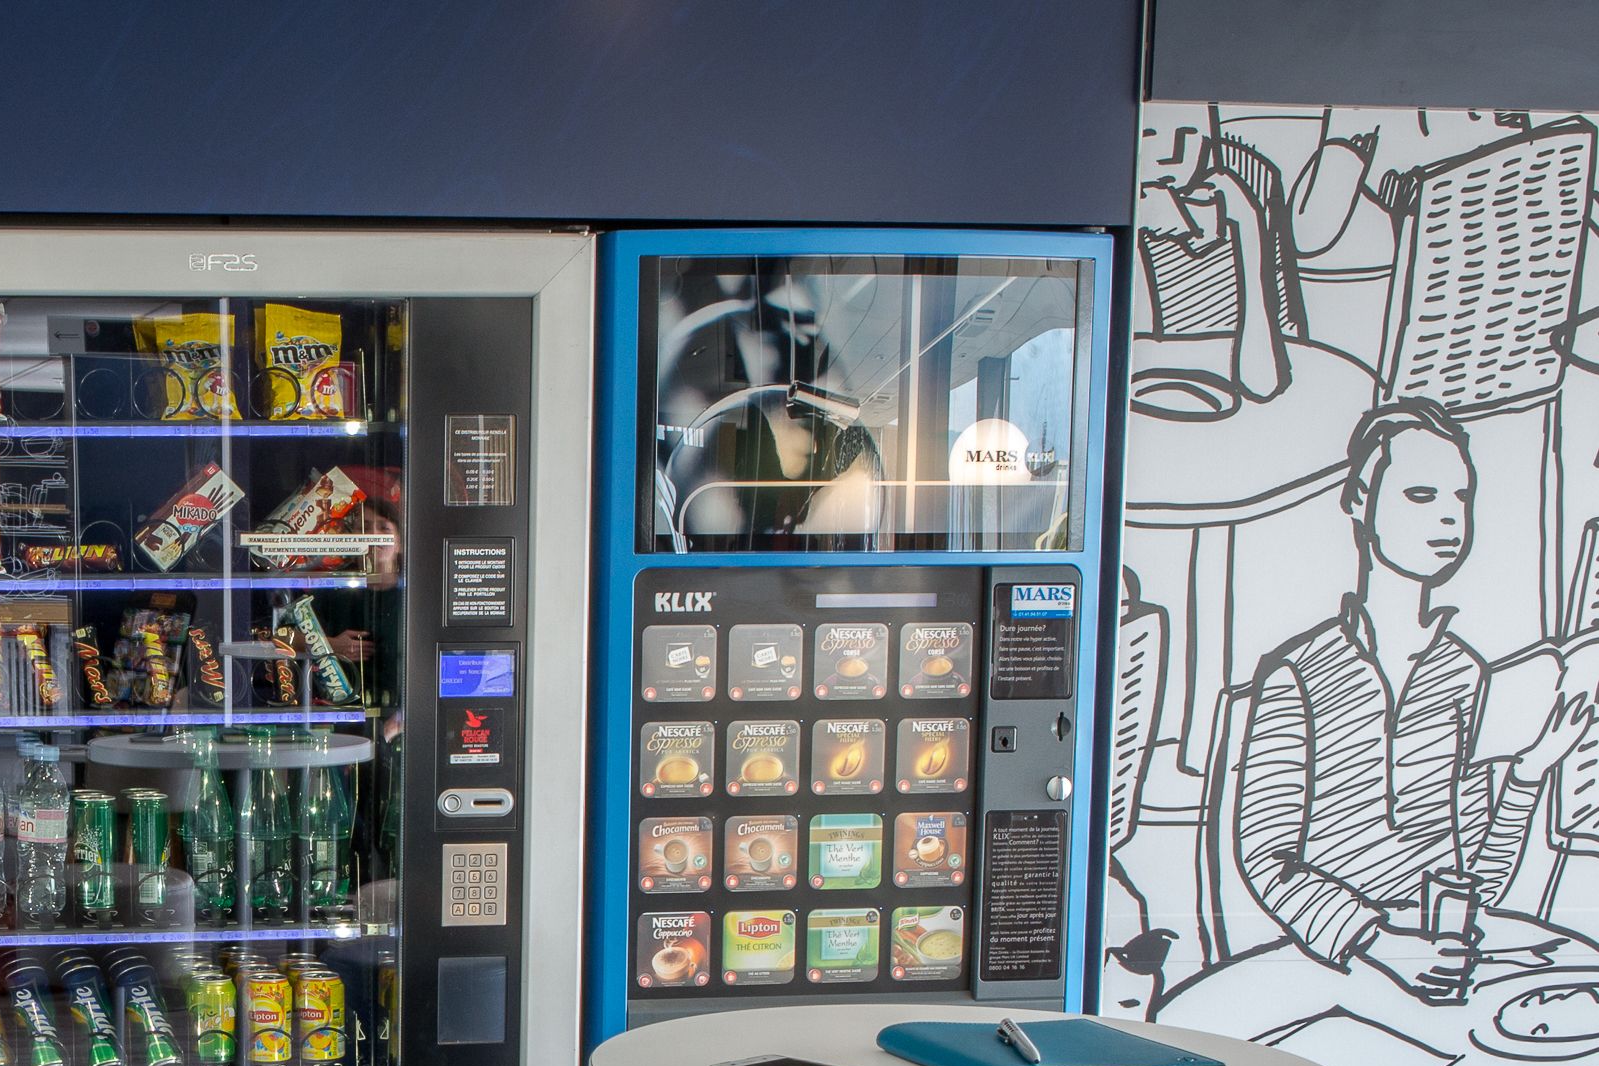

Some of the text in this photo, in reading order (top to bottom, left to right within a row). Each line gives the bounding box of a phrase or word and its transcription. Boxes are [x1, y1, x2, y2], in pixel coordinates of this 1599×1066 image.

[966, 450, 1018, 463] MARS
[173, 504, 217, 521] MIKADO
[1015, 587, 1072, 601] MARS
[654, 592, 712, 612] KLIX
[830, 627, 873, 639] NESCAFÉ
[915, 627, 957, 639] NESCAFÉ
[1016, 624, 1047, 633] journée?
[658, 725, 701, 738] NESCAFÉ
[743, 724, 786, 736] NESCAFÉ
[827, 722, 870, 734] NESCAFÉ
[912, 720, 954, 733] NESCAFÉ
[647, 730, 702, 756] Espresso
[732, 730, 788, 755] Espresso
[917, 821, 945, 829] Maxwell
[845, 844, 864, 852] Vert
[828, 853, 861, 863] Menthe
[652, 916, 696, 929] NESCAFÉ
[740, 922, 778, 934] Lipton
[653, 928, 693, 940] Cappuccino
[736, 942, 782, 951] THÉ CITRON
[300, 1010, 322, 1019] ipton
